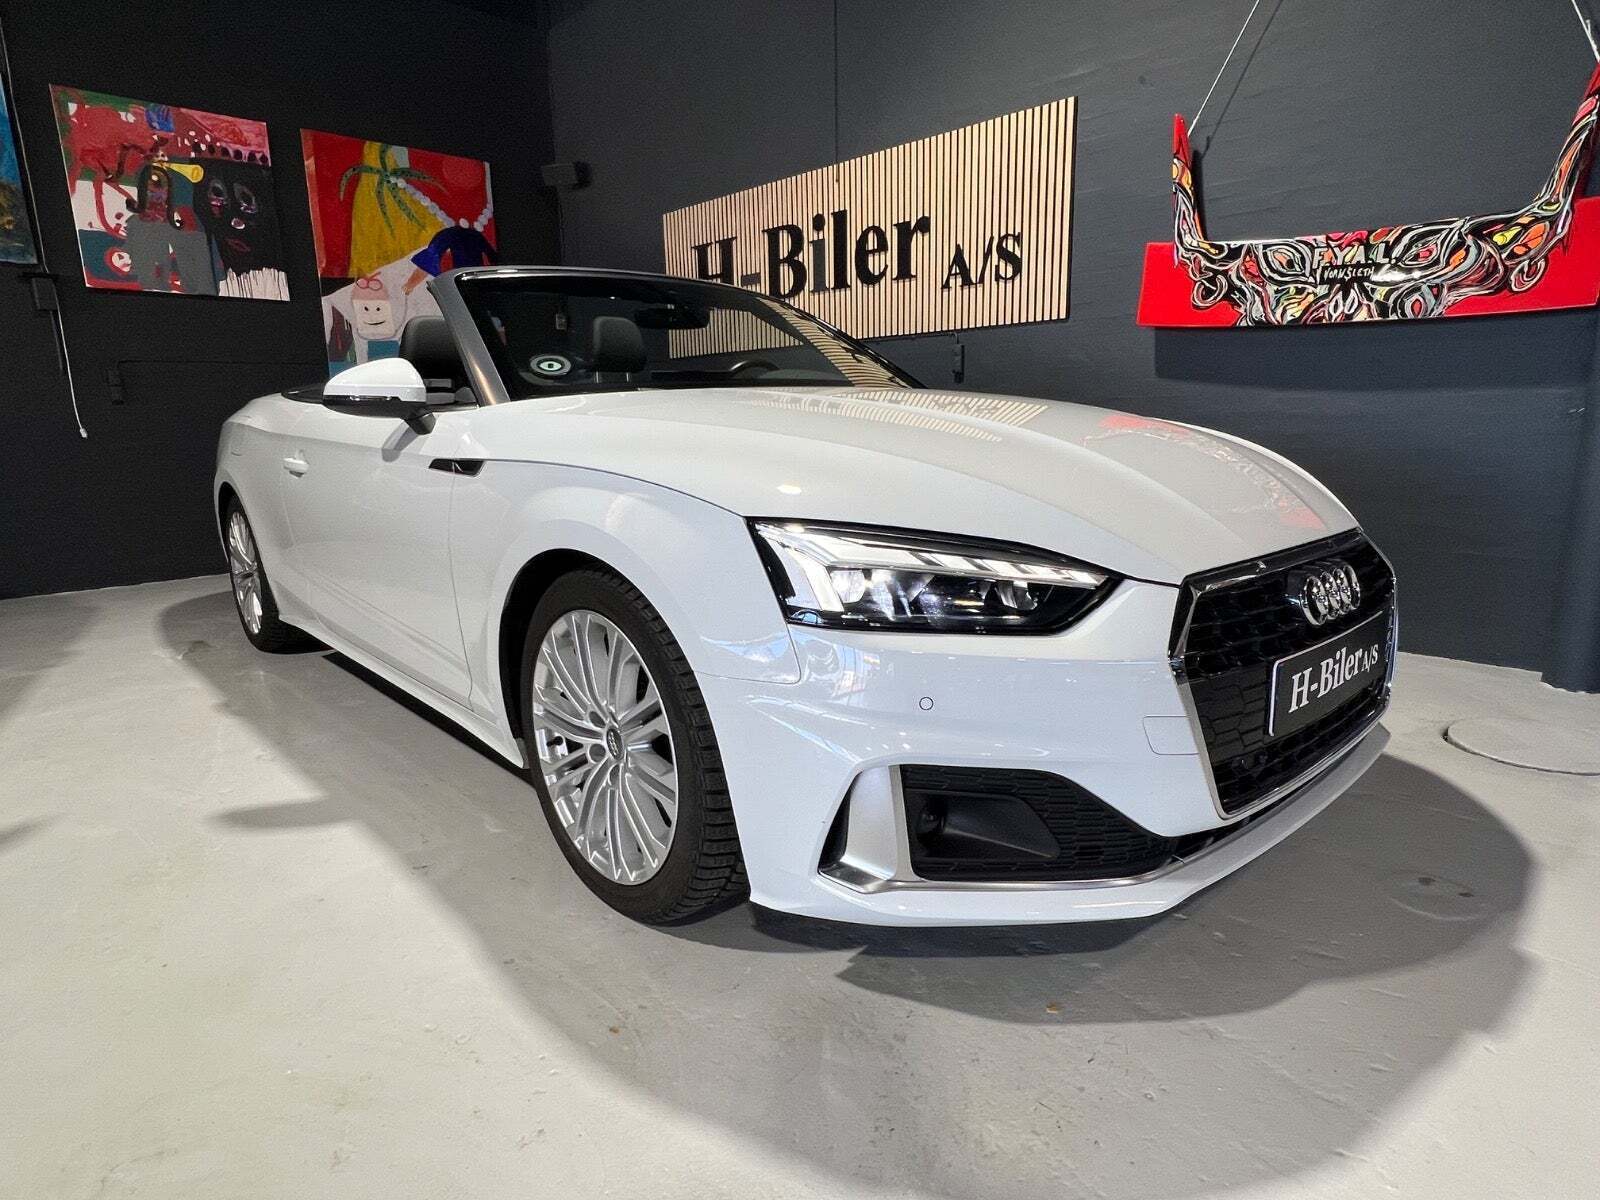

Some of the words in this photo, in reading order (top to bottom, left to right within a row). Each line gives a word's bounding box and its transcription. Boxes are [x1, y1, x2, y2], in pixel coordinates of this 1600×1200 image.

[691, 209, 932, 299] H-Biler
[940, 231, 1023, 291] A/S
[1288, 646, 1363, 713] H-Biler
[1361, 644, 1379, 672] A/S
